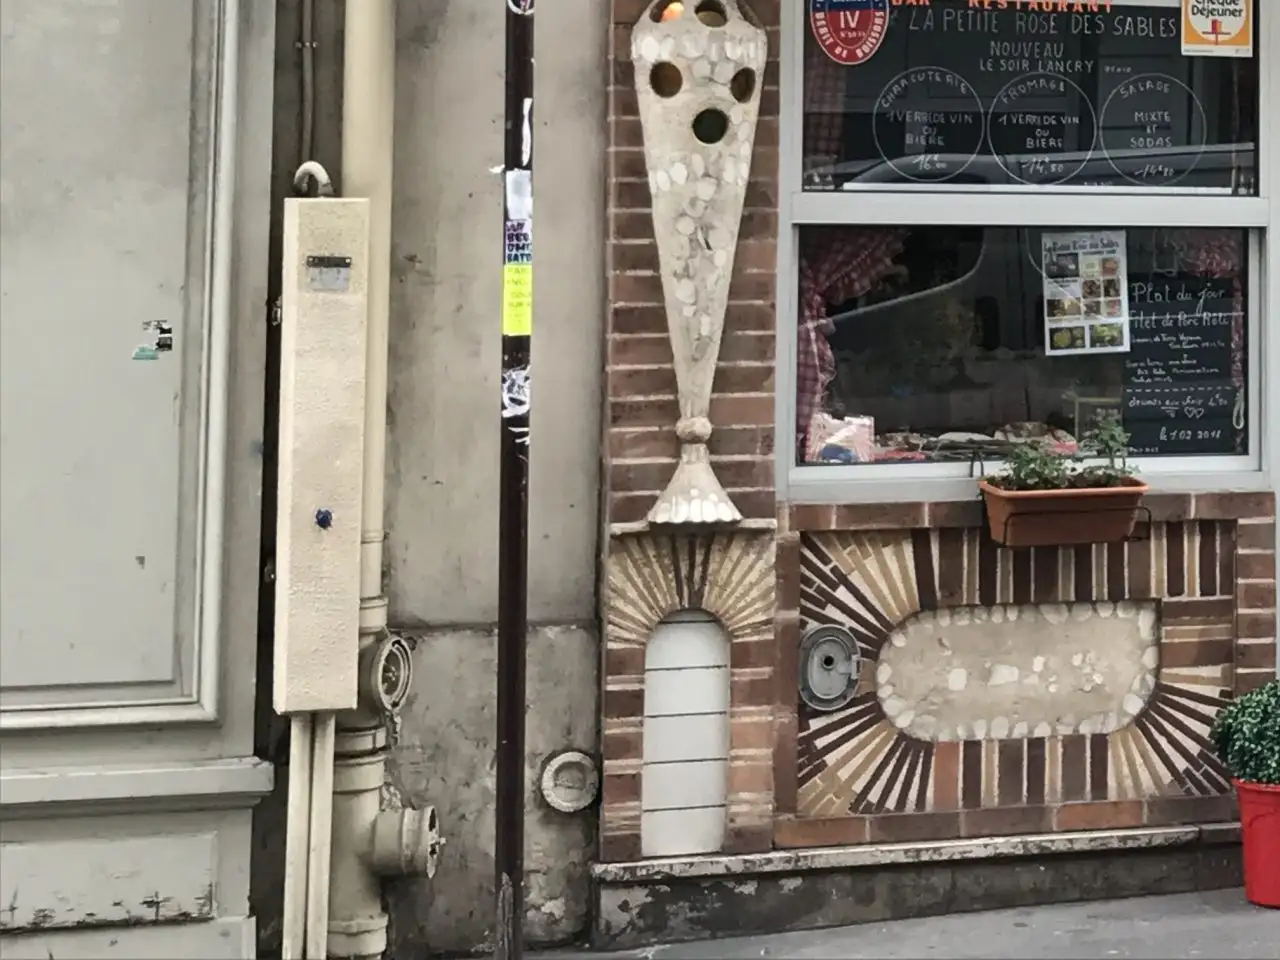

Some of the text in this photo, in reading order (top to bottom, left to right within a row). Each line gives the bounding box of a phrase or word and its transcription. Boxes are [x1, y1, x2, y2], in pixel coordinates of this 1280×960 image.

[840, 10, 860, 29] IV
[1191, 5, 1243, 20] Déjeuner
[909, 9, 1176, 38] LA PETITE ROSE DES SABLES
[990, 41, 1064, 58] NOUVEAU
[980, 59, 993, 72] LE
[1000, 59, 1030, 72] SOIR
[1120, 80, 1170, 99] SALADE
[949, 114, 972, 124] VIN
[1060, 116, 1079, 124] VIN
[1134, 111, 1171, 122] MIXTE
[1130, 137, 1172, 148] SODAS
[1131, 281, 1225, 316] Plat du jour
